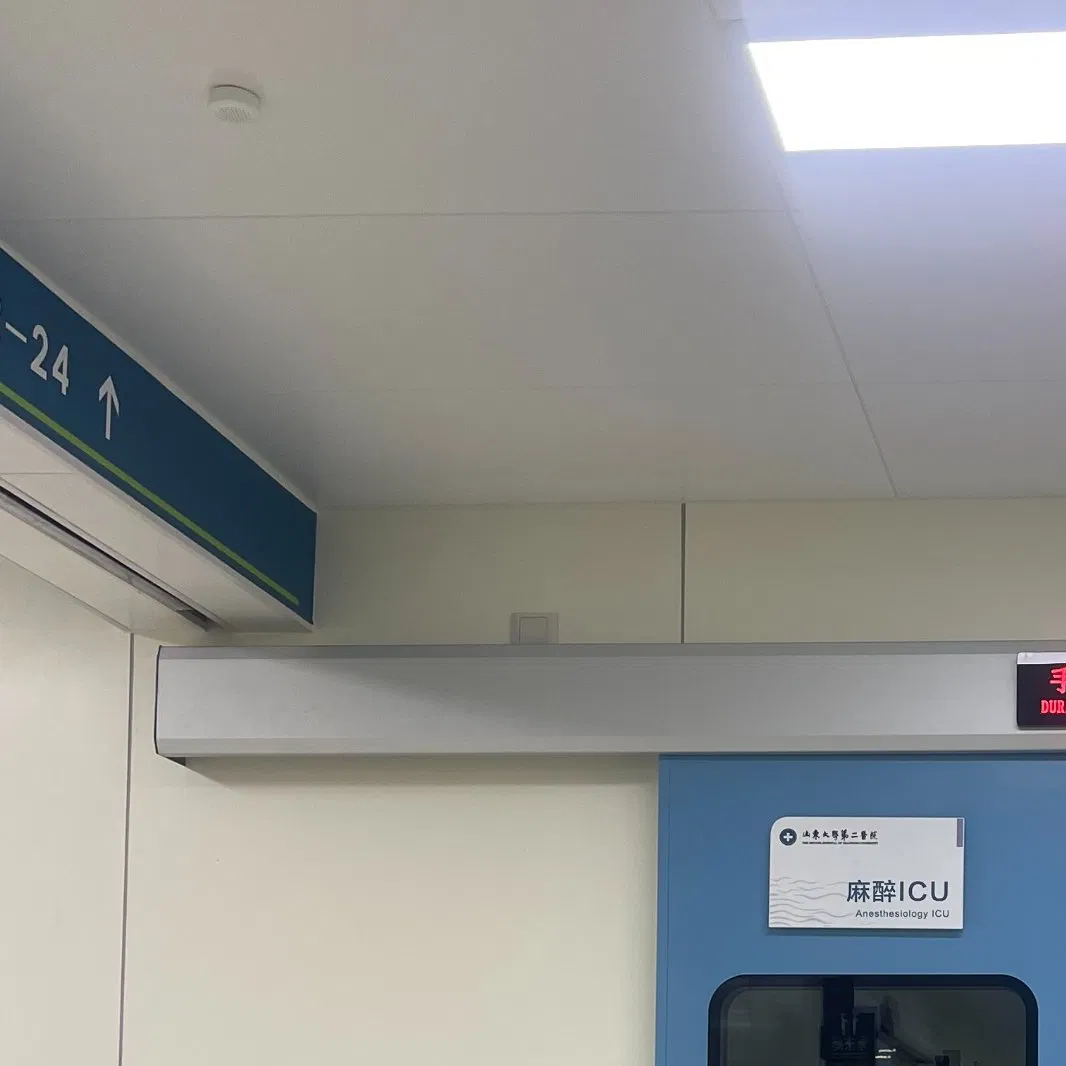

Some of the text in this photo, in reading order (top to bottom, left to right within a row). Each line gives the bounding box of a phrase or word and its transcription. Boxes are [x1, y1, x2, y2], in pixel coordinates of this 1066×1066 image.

[0, 302, 69, 396] -24
[846, 879, 949, 903] 麻醉ICU
[855, 909, 950, 920] Anesthesiology ICU
